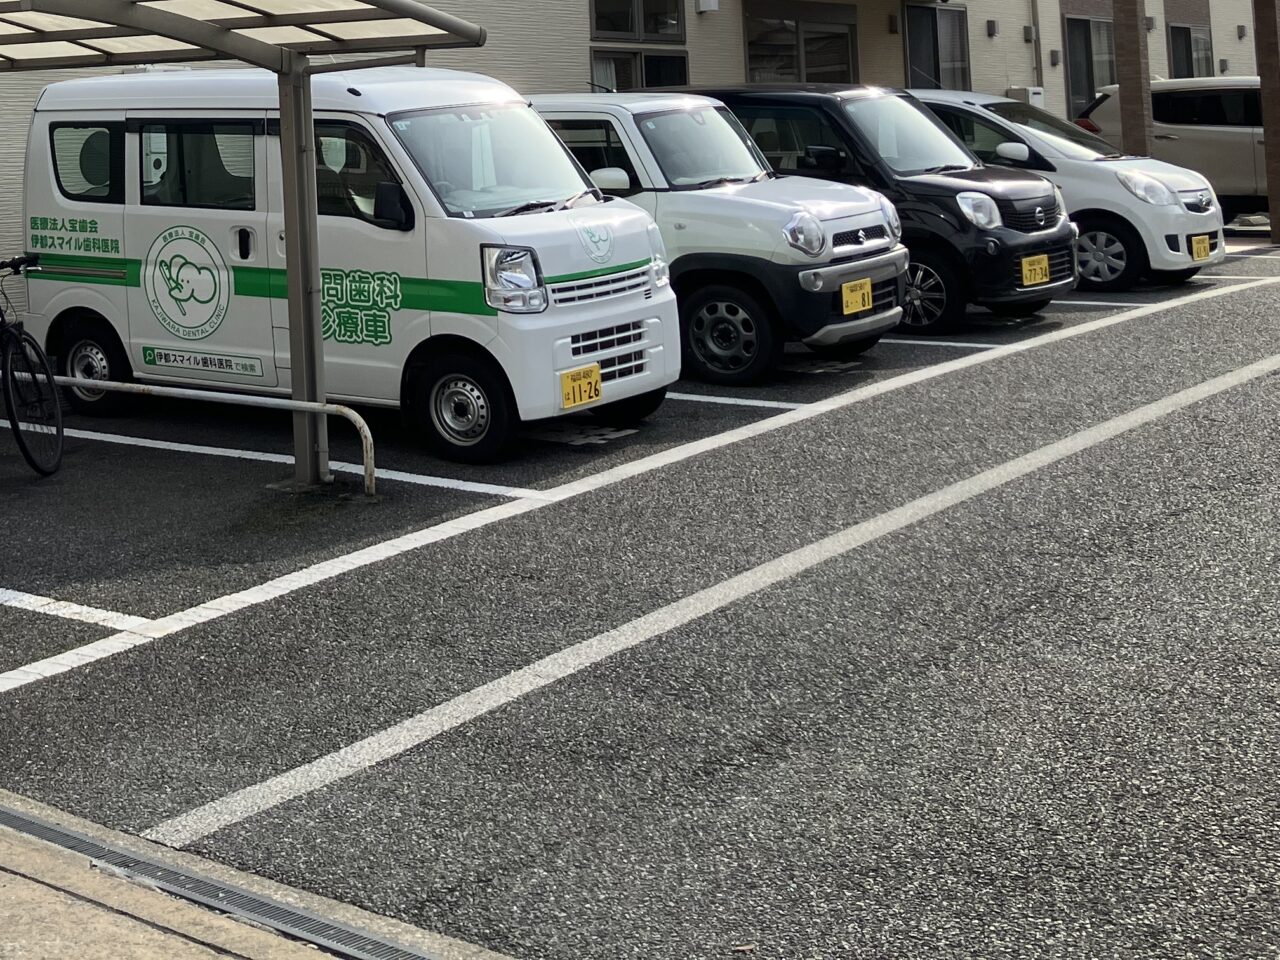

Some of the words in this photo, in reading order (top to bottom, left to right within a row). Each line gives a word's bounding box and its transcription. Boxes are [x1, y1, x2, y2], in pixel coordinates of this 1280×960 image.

[30, 216, 98, 233] 医療法人宝歯会
[31, 234, 120, 254] 伊都スマイル歯科医院
[152, 299, 180, 334] KAJIWARA
[182, 328, 209, 337] DENTAL
[209, 304, 224, 329] CLINIC
